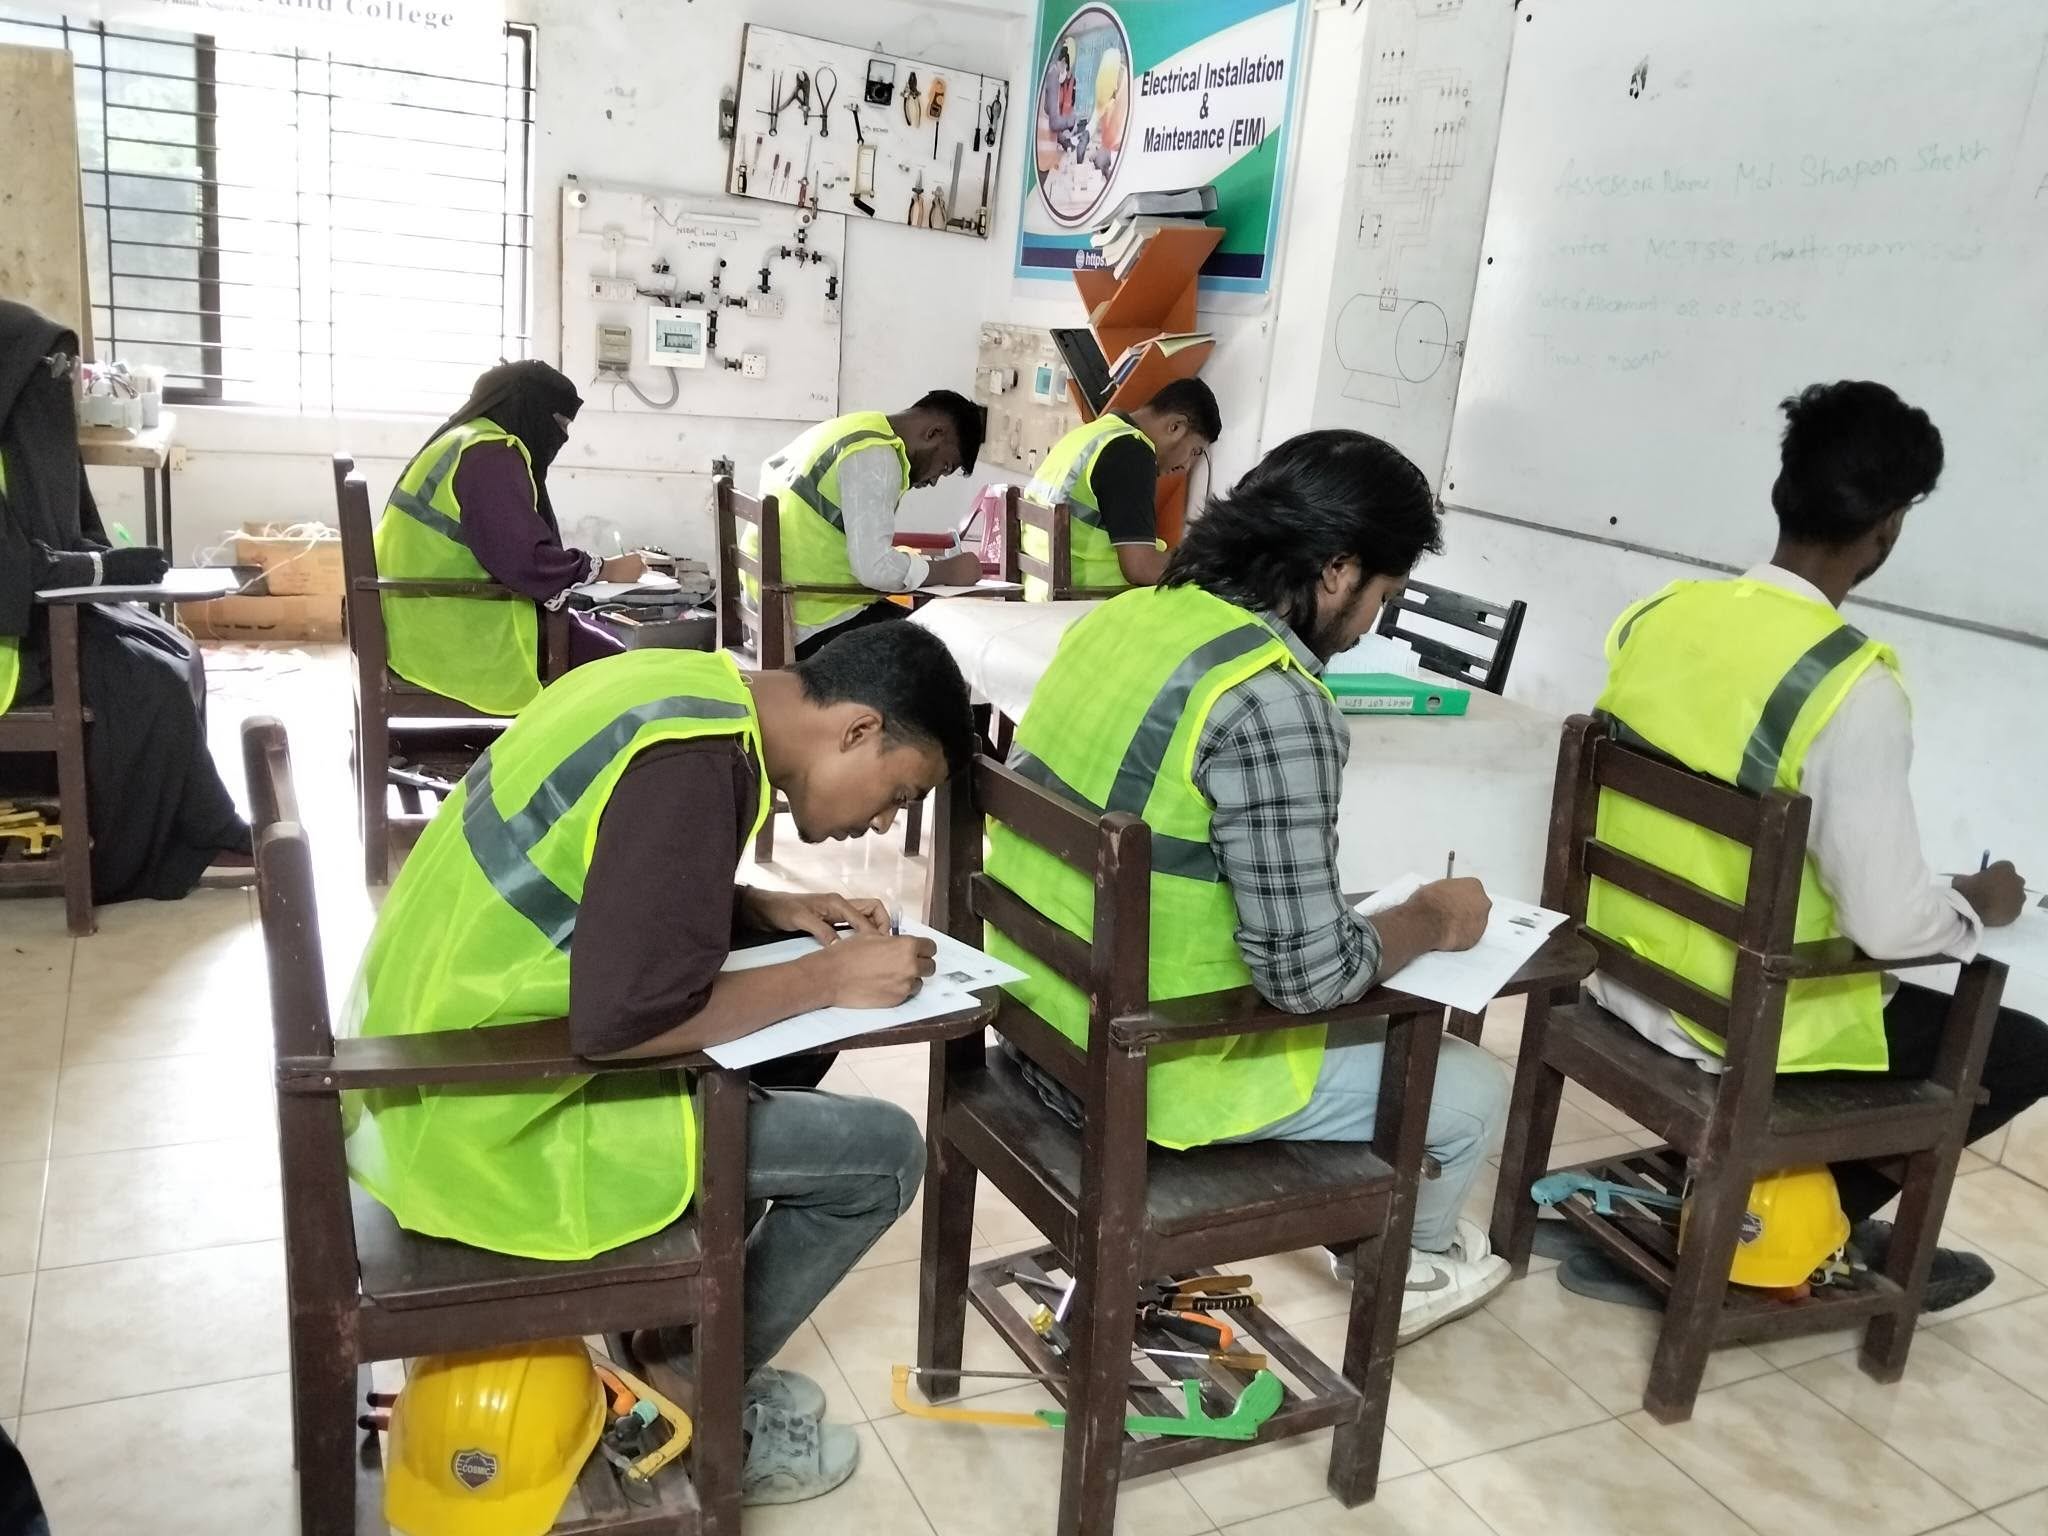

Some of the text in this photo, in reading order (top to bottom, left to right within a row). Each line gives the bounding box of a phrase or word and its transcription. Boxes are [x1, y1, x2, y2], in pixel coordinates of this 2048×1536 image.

[346, 0, 454, 29] College
[1141, 54, 1284, 97] Electrical Installation
[1199, 92, 1209, 119] &
[1143, 116, 1266, 155] Maintenance (EIM)
